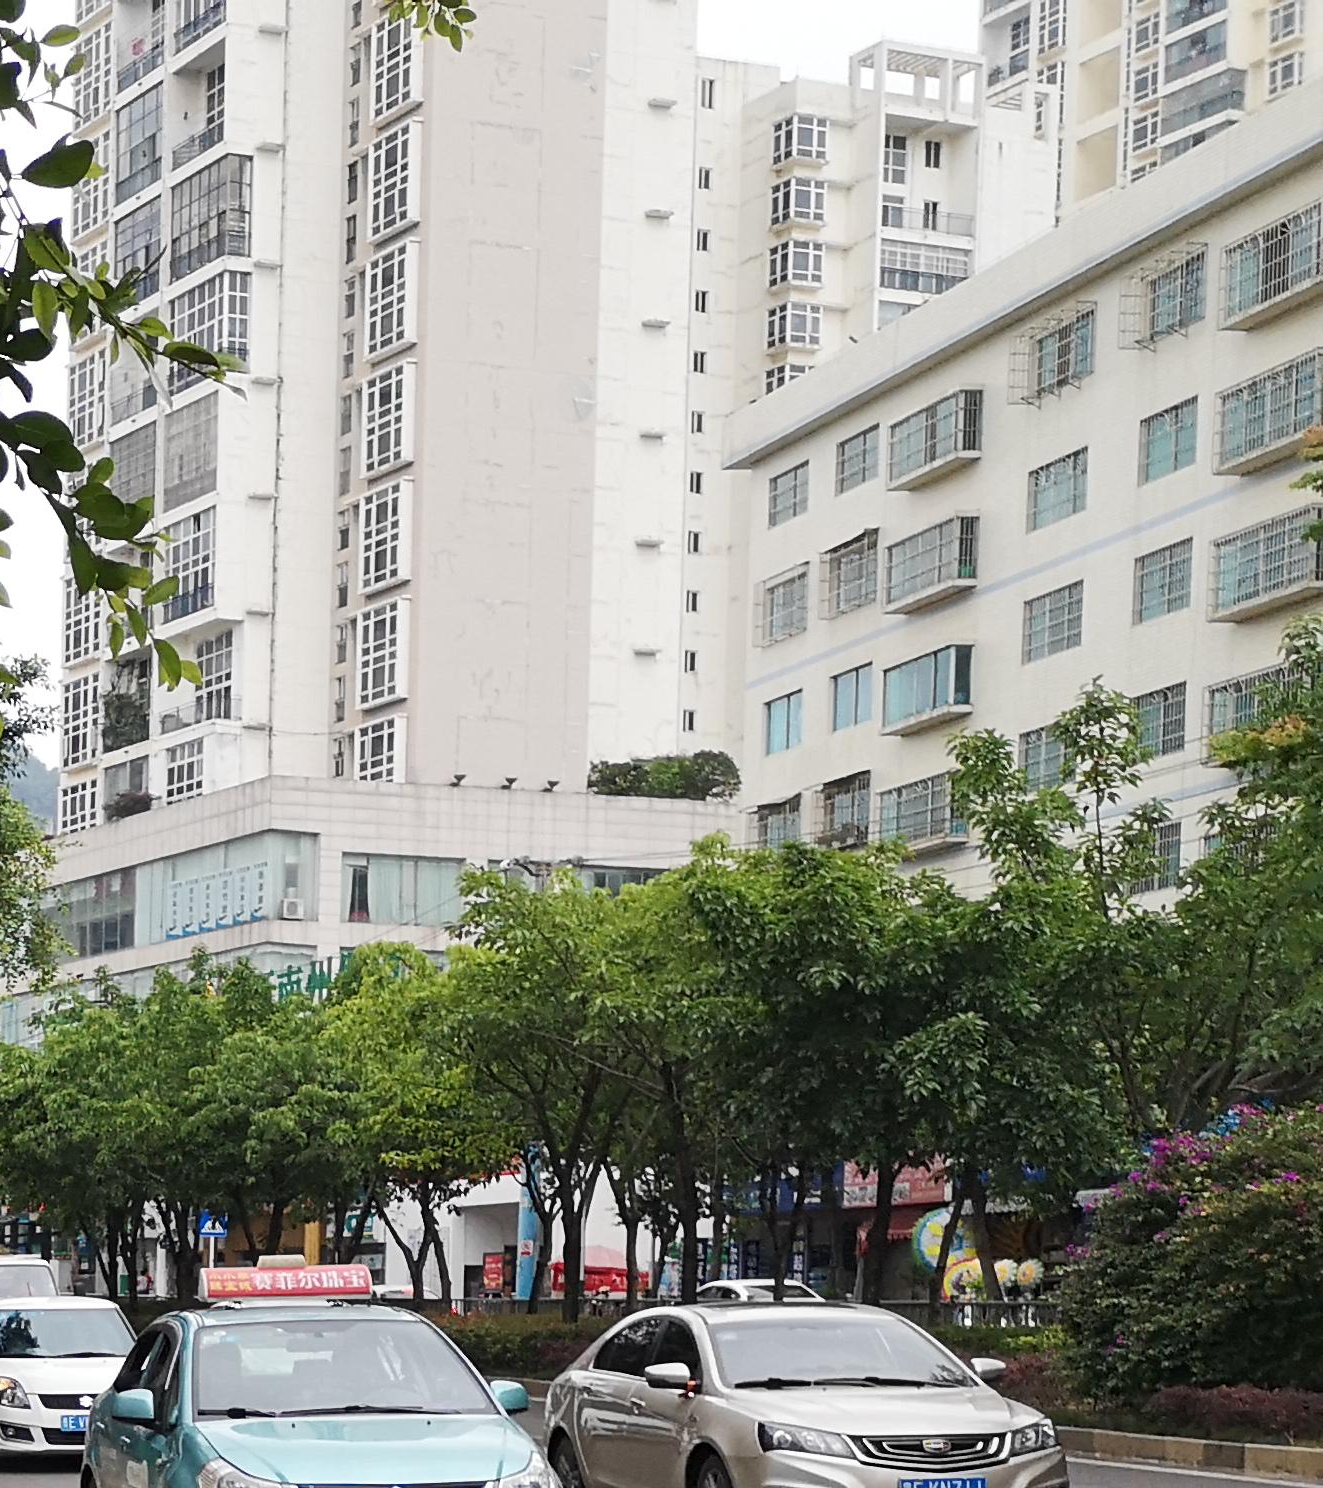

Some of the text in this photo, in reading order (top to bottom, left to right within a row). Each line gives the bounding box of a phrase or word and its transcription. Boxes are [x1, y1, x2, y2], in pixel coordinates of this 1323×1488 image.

[251, 1270, 366, 1291] 赛菲尔珠宝
